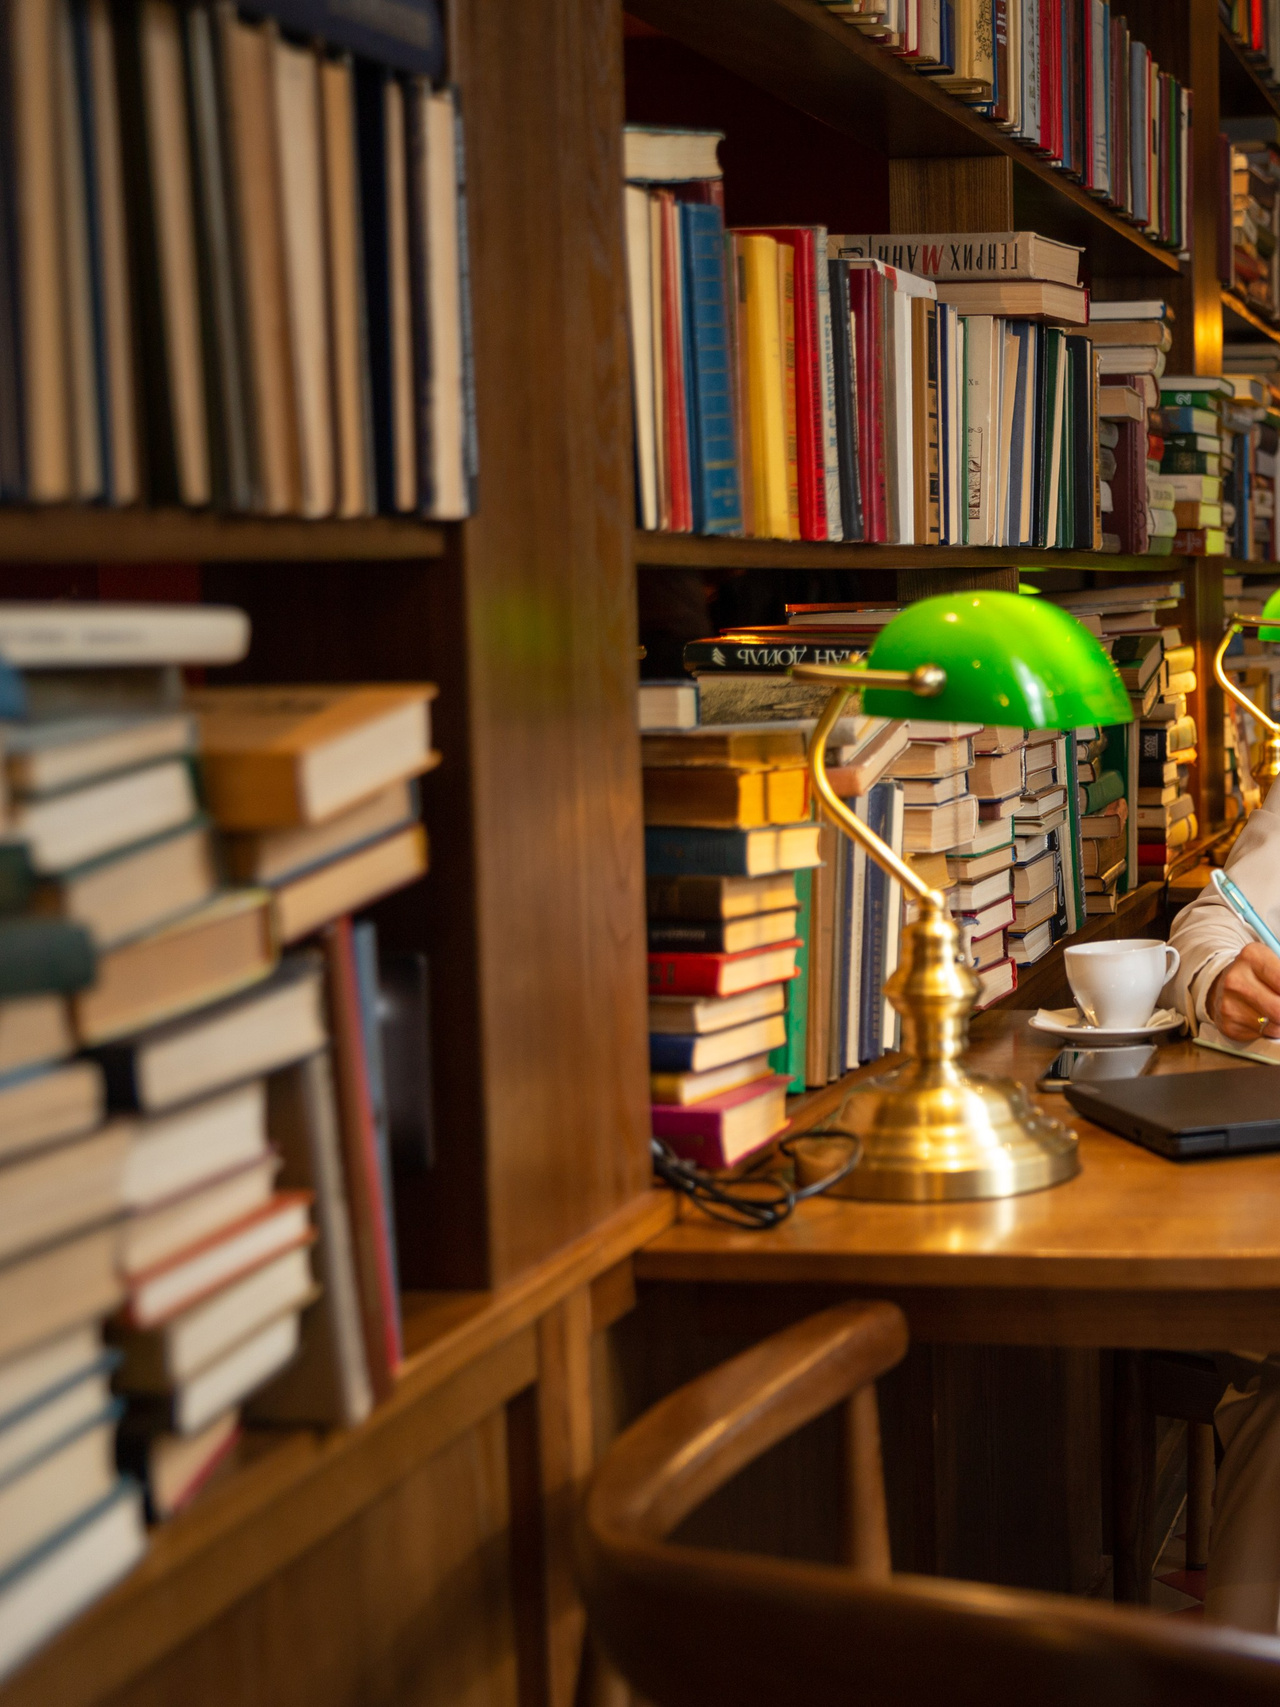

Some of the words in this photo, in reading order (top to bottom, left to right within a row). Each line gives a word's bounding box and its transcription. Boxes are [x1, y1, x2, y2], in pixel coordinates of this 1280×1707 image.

[878, 244, 944, 275] МАНН
[950, 243, 1018, 271] ГЕНРИХ
[737, 645, 808, 666] ДОЙЛЬ
